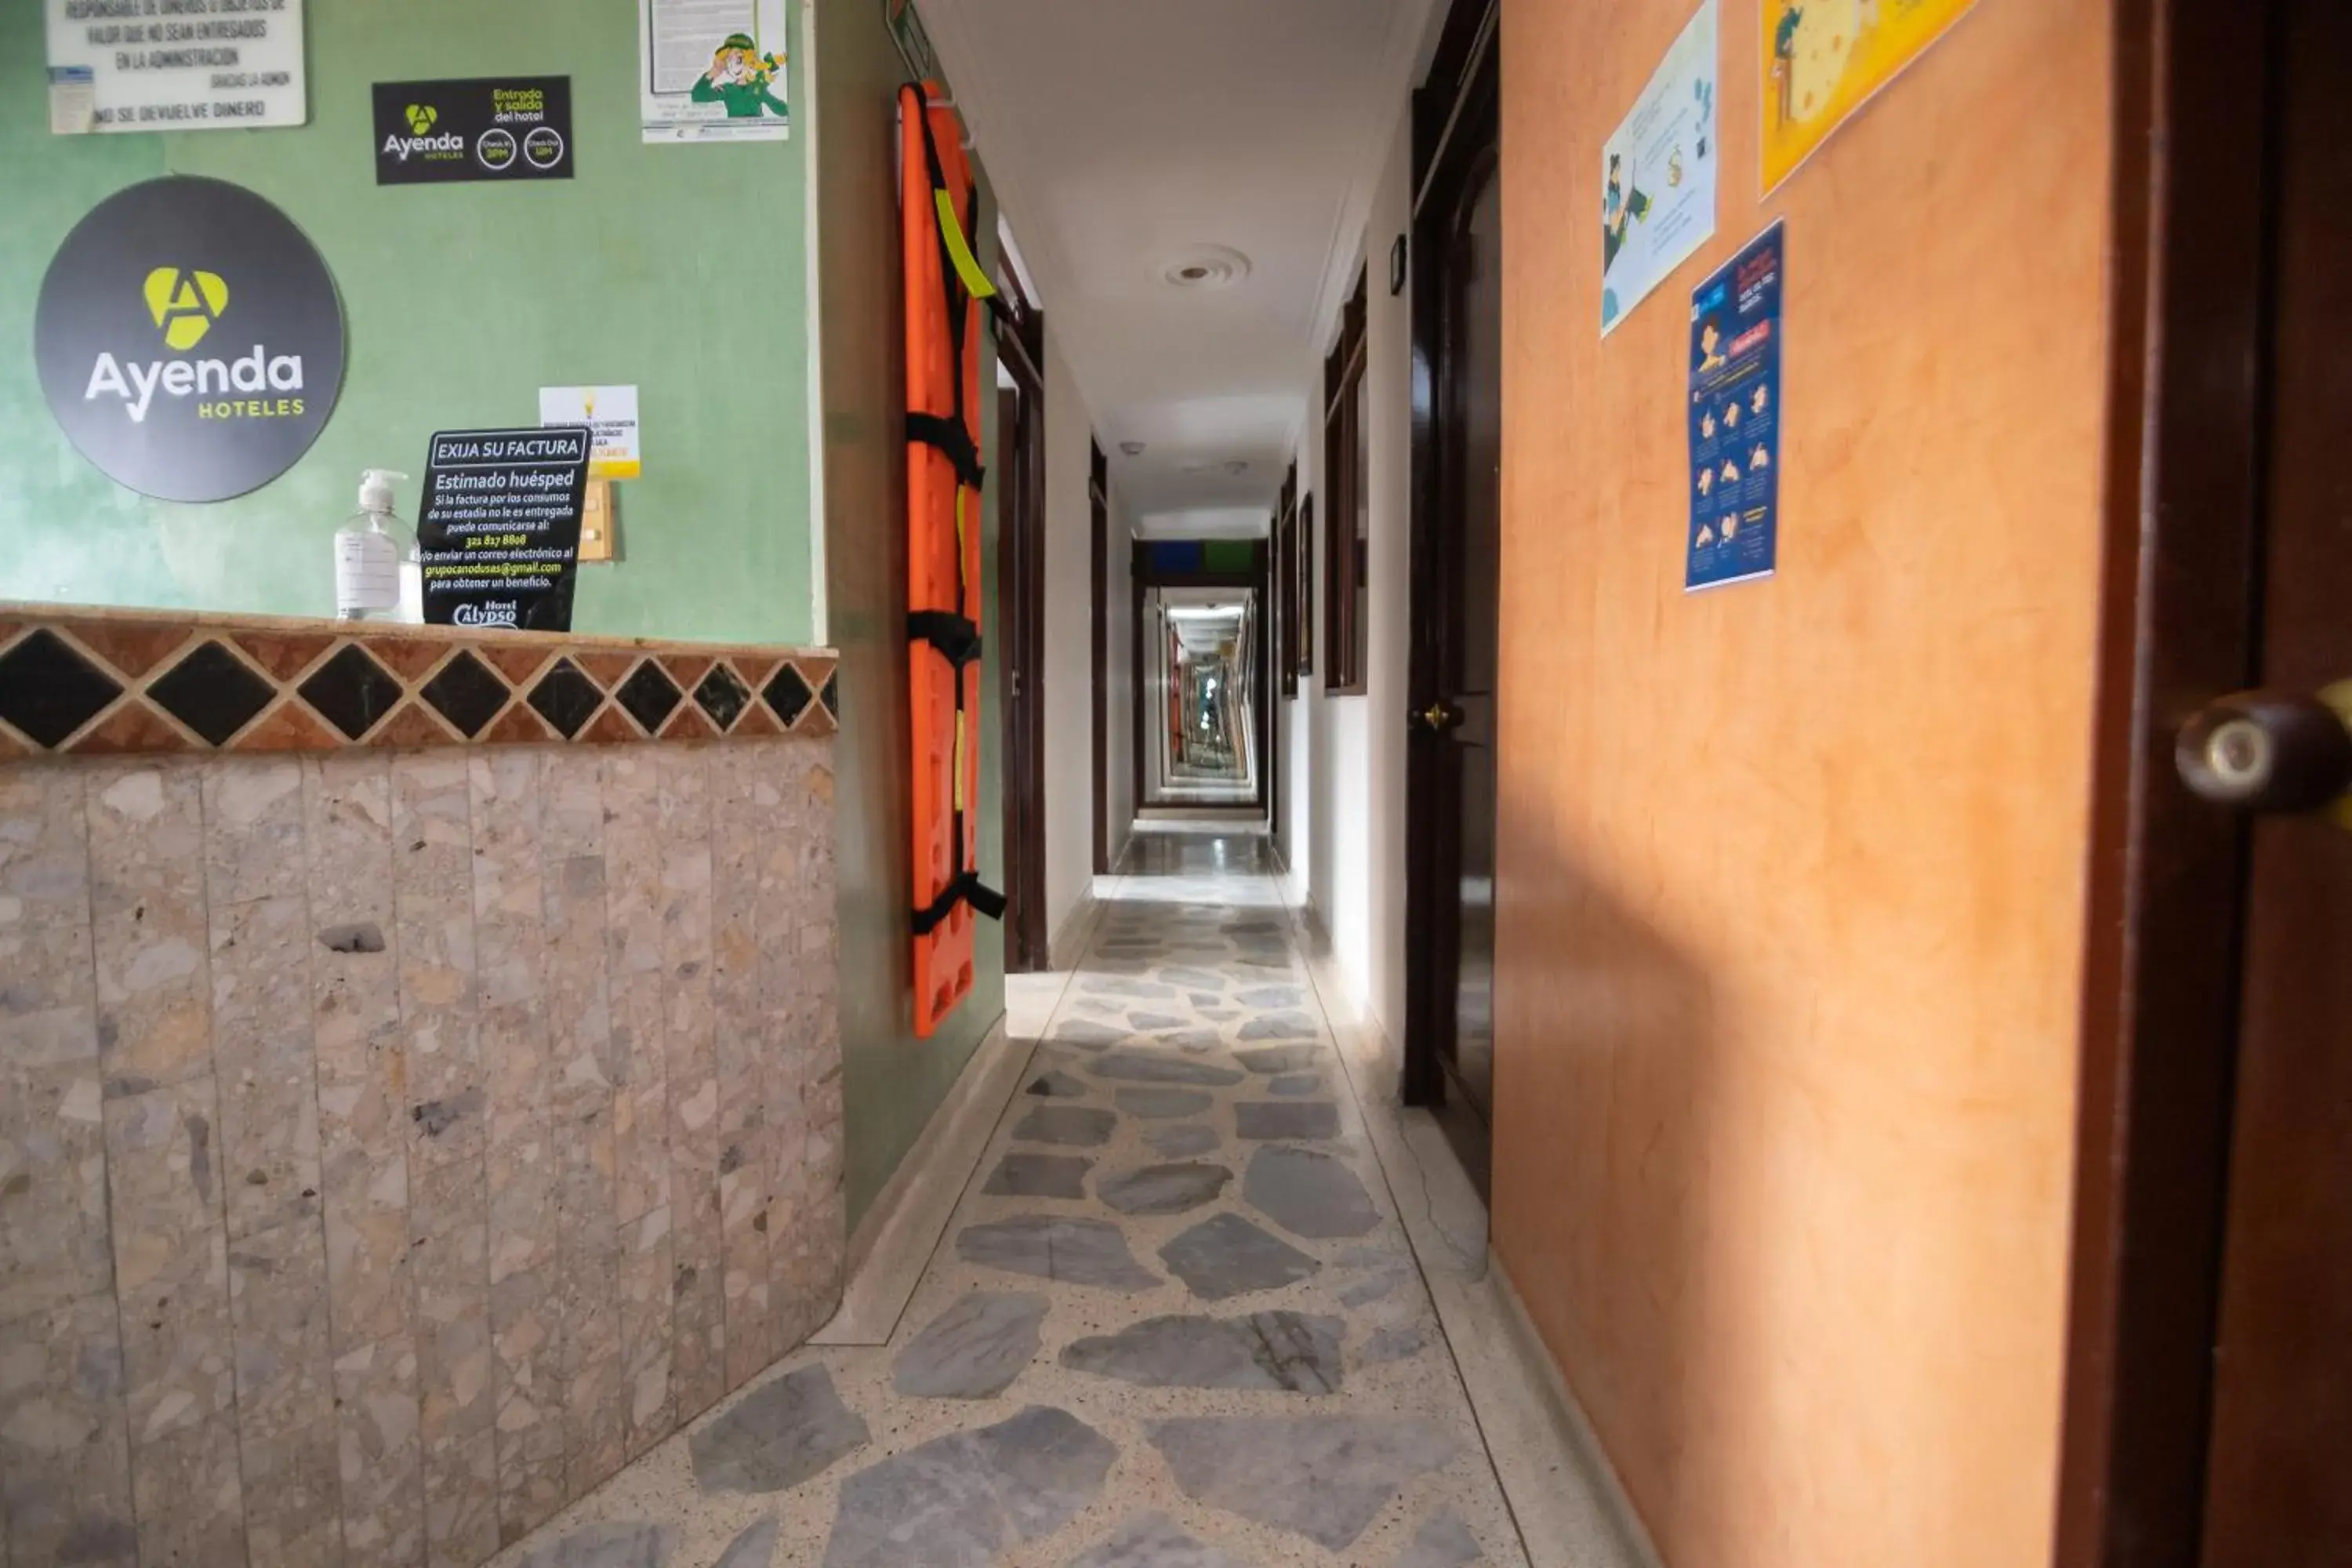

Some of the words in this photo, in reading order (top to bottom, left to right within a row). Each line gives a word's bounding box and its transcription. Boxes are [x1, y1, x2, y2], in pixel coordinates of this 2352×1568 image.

[492, 88, 543, 100] Entrada
[118, 107, 135, 122] SE
[139, 103, 209, 122] DEVUELVE
[212, 100, 266, 118] DINERO
[495, 101, 503, 113] y
[504, 98, 543, 111] salida
[495, 111, 514, 122] del
[514, 110, 544, 122] hotel
[383, 132, 464, 162] Ayenda
[85, 344, 303, 423] Ayenda
[198, 398, 304, 419] HOTELES
[437, 443, 480, 459] EXIJA
[482, 442, 504, 457] SU
[507, 439, 579, 456] FACTURA
[435, 471, 506, 490] Estimado
[510, 469, 575, 492] huésped
[445, 493, 454, 506] la
[456, 493, 488, 506] factura
[490, 495, 506, 506] por
[507, 492, 521, 503] los
[522, 493, 571, 503] consumos
[427, 508, 440, 520] de
[441, 510, 452, 519] su
[488, 509, 501, 517] no
[503, 506, 511, 517] le
[512, 509, 524, 517] es
[524, 505, 573, 520] entregada
[446, 521, 476, 535] puede
[477, 521, 536, 532] comunicarse
[434, 548, 463, 561] enviar
[464, 550, 477, 560] un
[477, 550, 509, 560] correo
[564, 546, 574, 558] al
[430, 579, 452, 593] para
[452, 577, 491, 589] obtener
[492, 579, 504, 588] un
[485, 599, 517, 611] Hotel
[453, 603, 517, 626] Calypso
